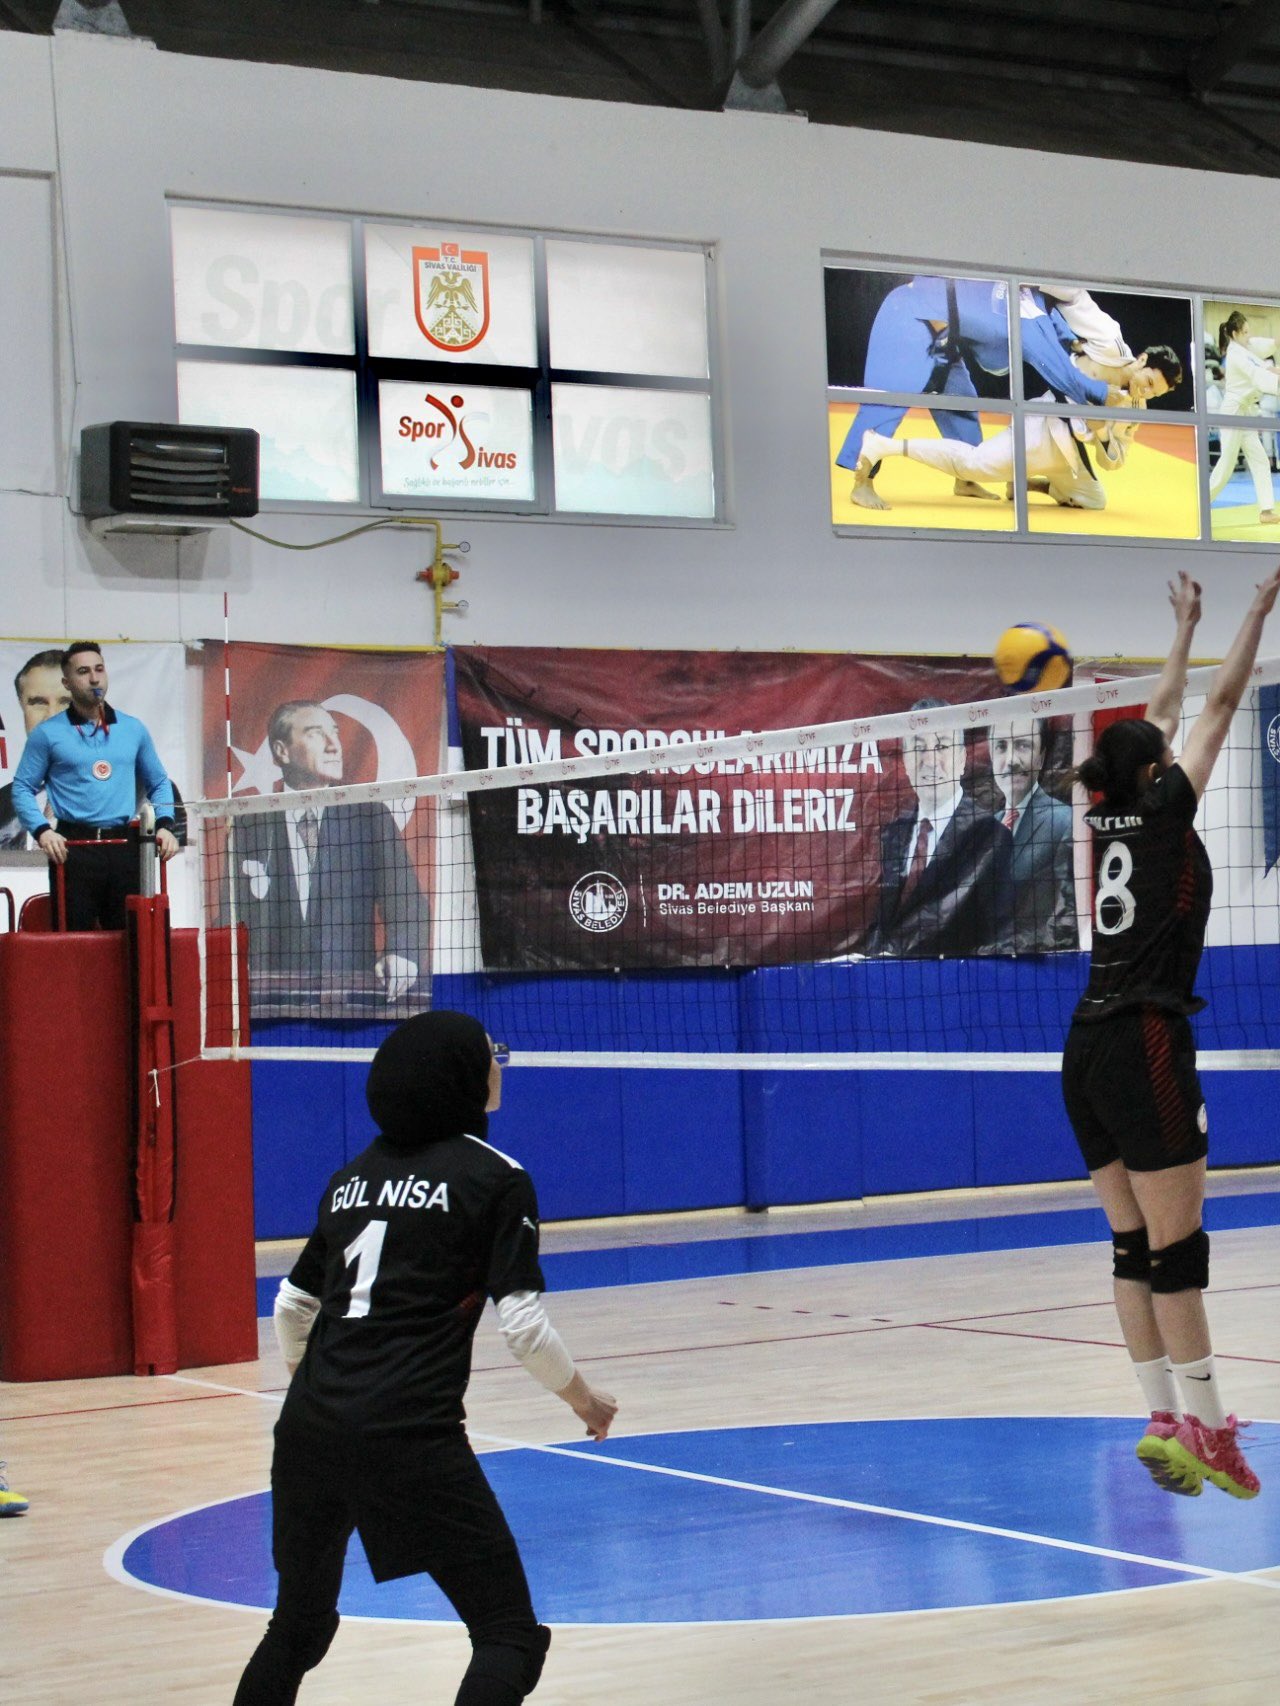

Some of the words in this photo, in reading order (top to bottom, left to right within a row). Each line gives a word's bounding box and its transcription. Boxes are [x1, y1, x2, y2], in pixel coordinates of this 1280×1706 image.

[398, 415, 445, 442] Spor
[805, 732, 816, 742] TVF
[860, 724, 871, 734] TVF
[917, 716, 928, 726] TVF
[977, 708, 989, 718] TVF
[1040, 699, 1052, 709] TVF
[1106, 689, 1118, 699] TVF
[481, 718, 562, 772] TÜM
[517, 788, 722, 844] BAŞARILAR
[733, 787, 856, 834] DİLERİZ
[657, 884, 690, 900] DR.
[695, 882, 753, 899] ADEM
[757, 880, 814, 898] UZUN
[659, 902, 694, 915] Sivas
[697, 901, 756, 915] Belediye
[761, 900, 815, 916] Başkanı
[1095, 841, 1137, 936] 8
[331, 1176, 369, 1213] GÜL
[377, 1174, 450, 1212] NİSA
[341, 1220, 388, 1319] 1
